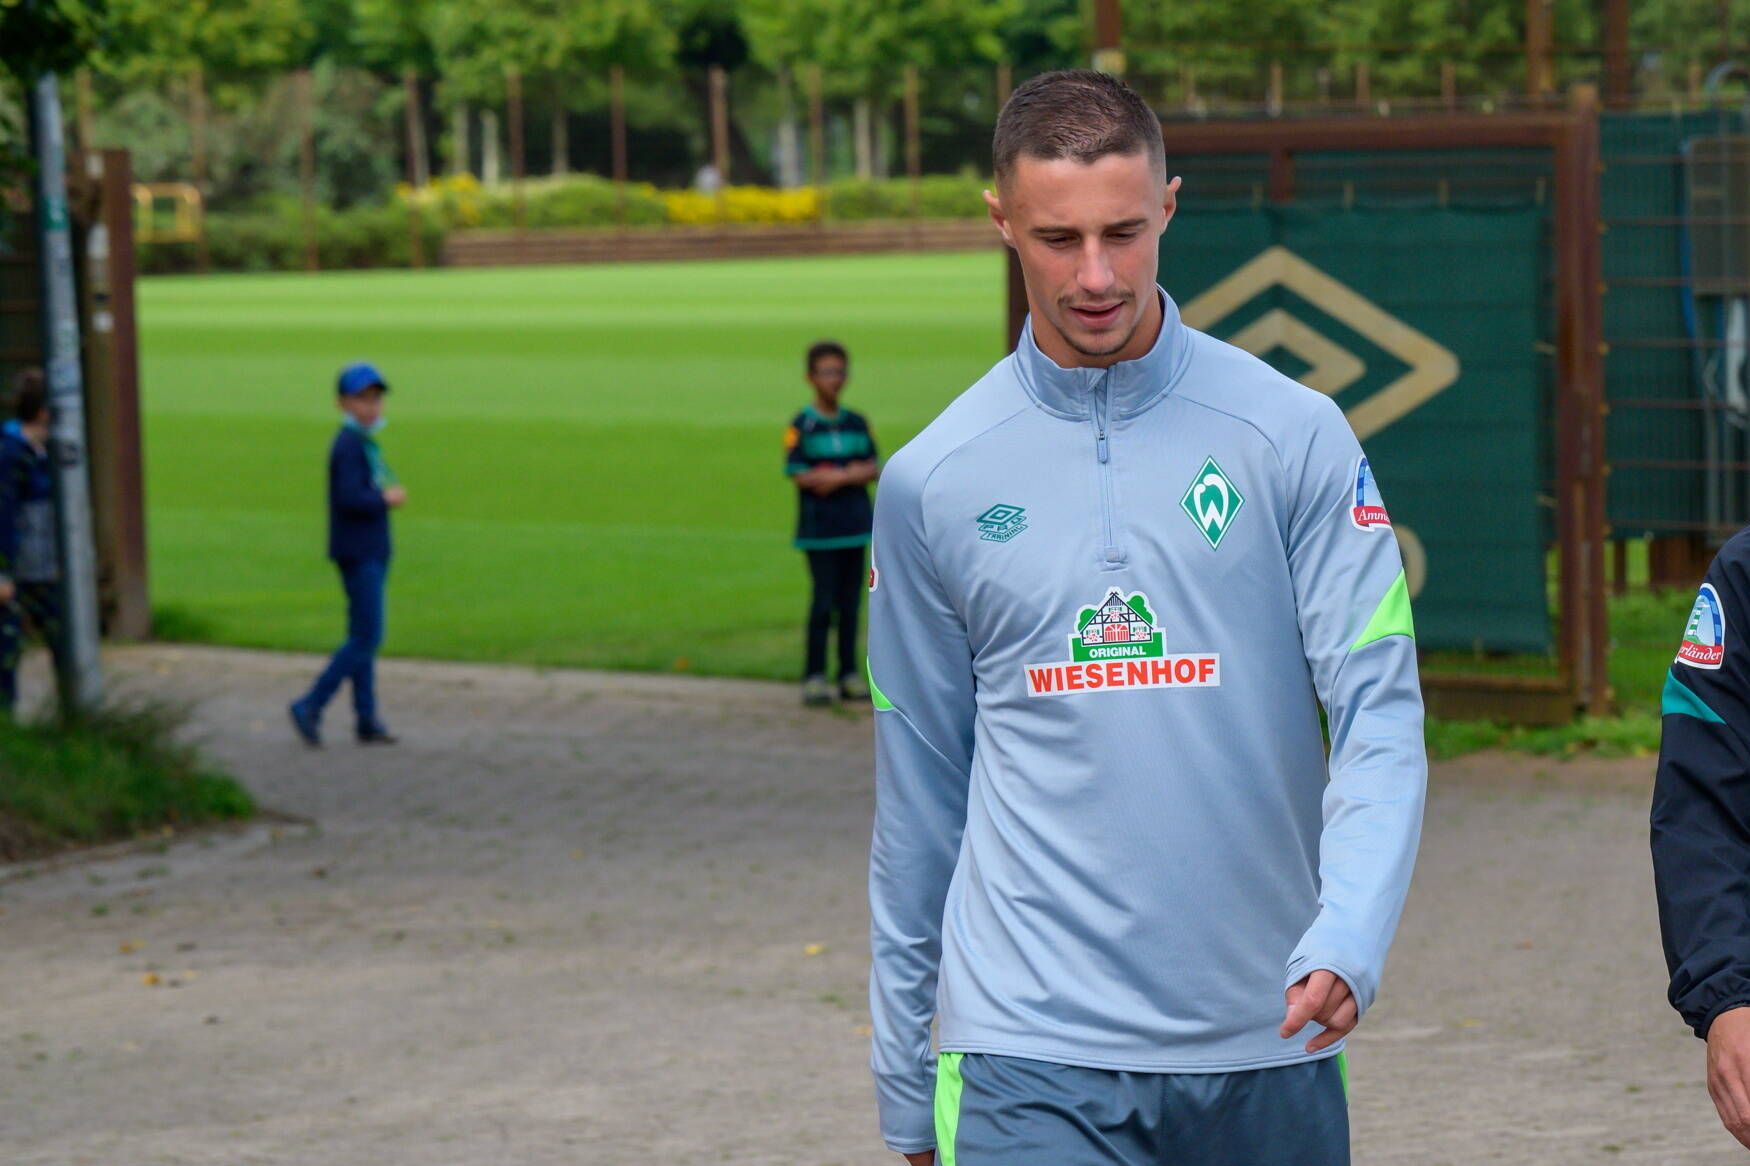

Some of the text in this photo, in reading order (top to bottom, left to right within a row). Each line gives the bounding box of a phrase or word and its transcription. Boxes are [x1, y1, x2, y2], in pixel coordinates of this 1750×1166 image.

[1357, 508, 1388, 521] Amm
[1089, 645, 1146, 659] ORIGINAL
[1029, 658, 1216, 694] WIESENHOF
